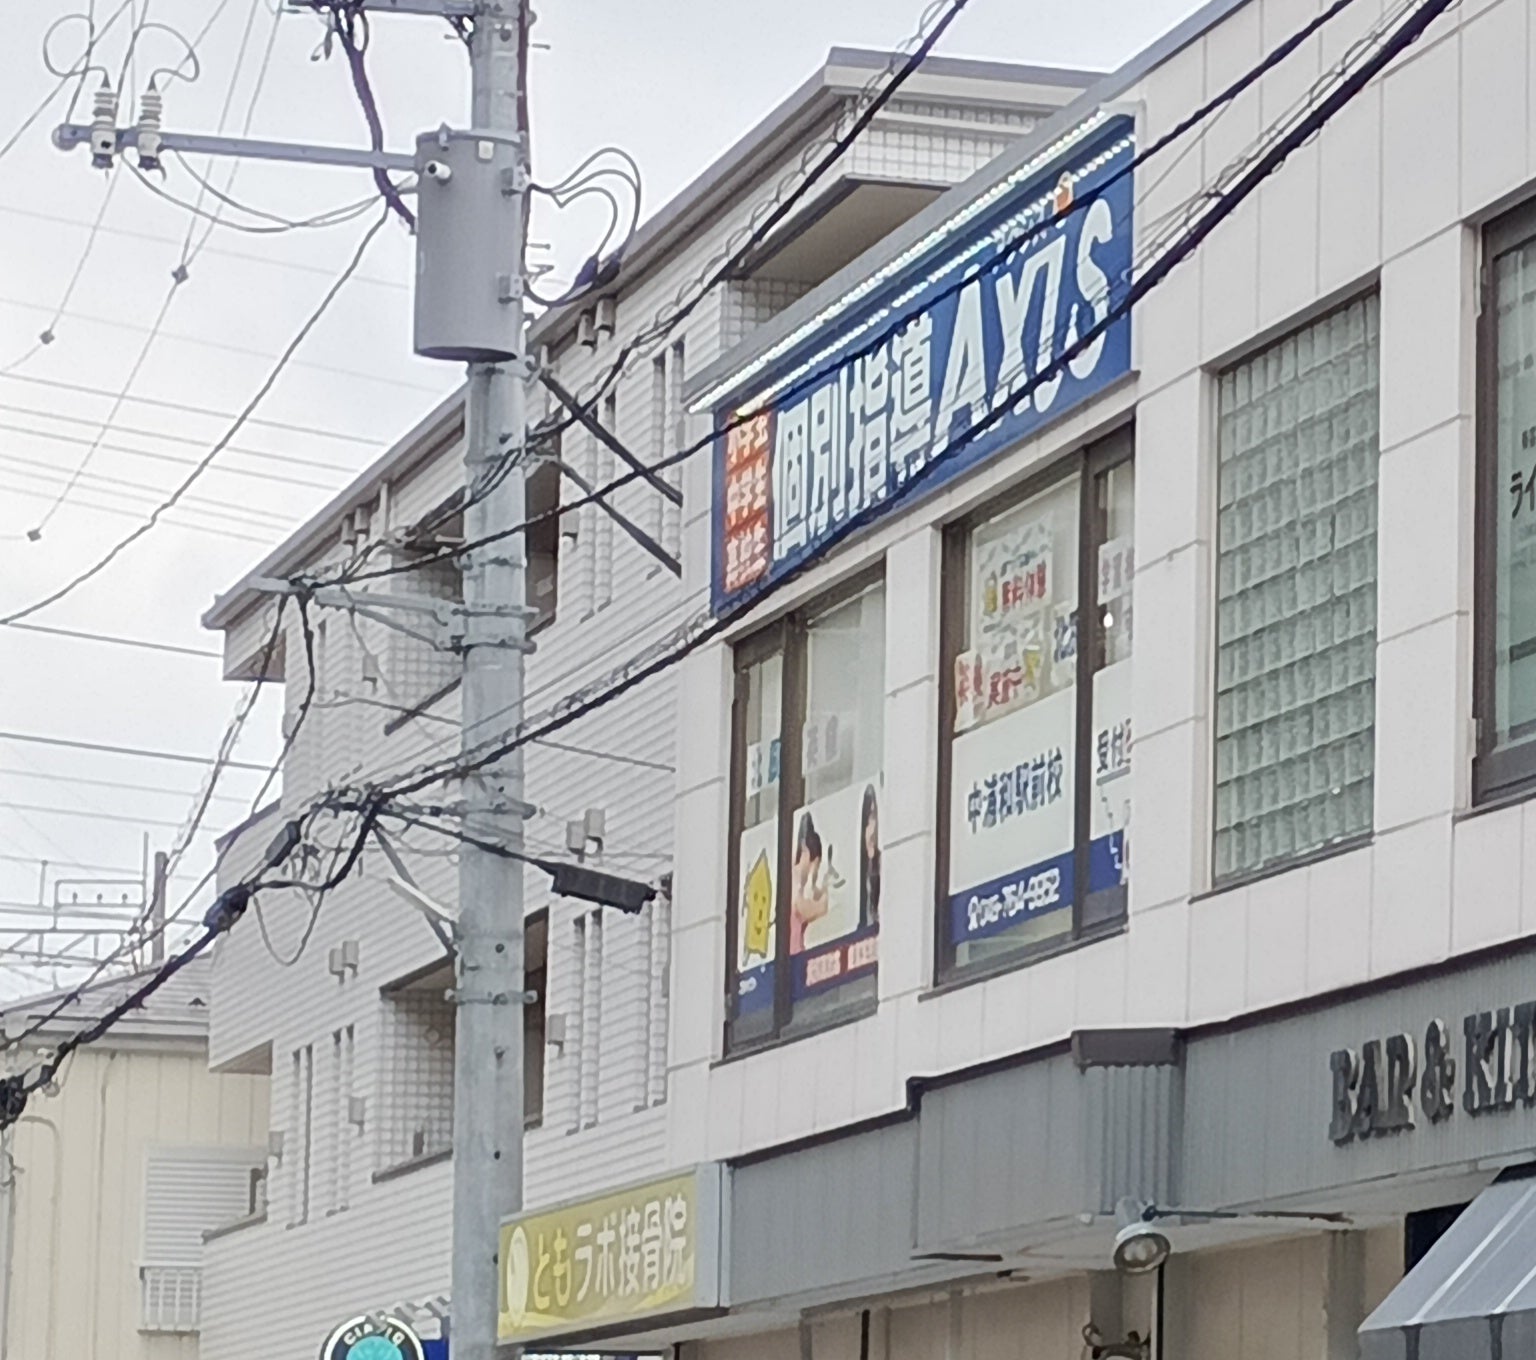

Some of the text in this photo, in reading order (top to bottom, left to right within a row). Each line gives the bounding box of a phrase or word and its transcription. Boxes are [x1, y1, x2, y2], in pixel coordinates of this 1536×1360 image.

[772, 308, 933, 561] 個別指導
[533, 1193, 688, 1310] ともラボ接骨院
